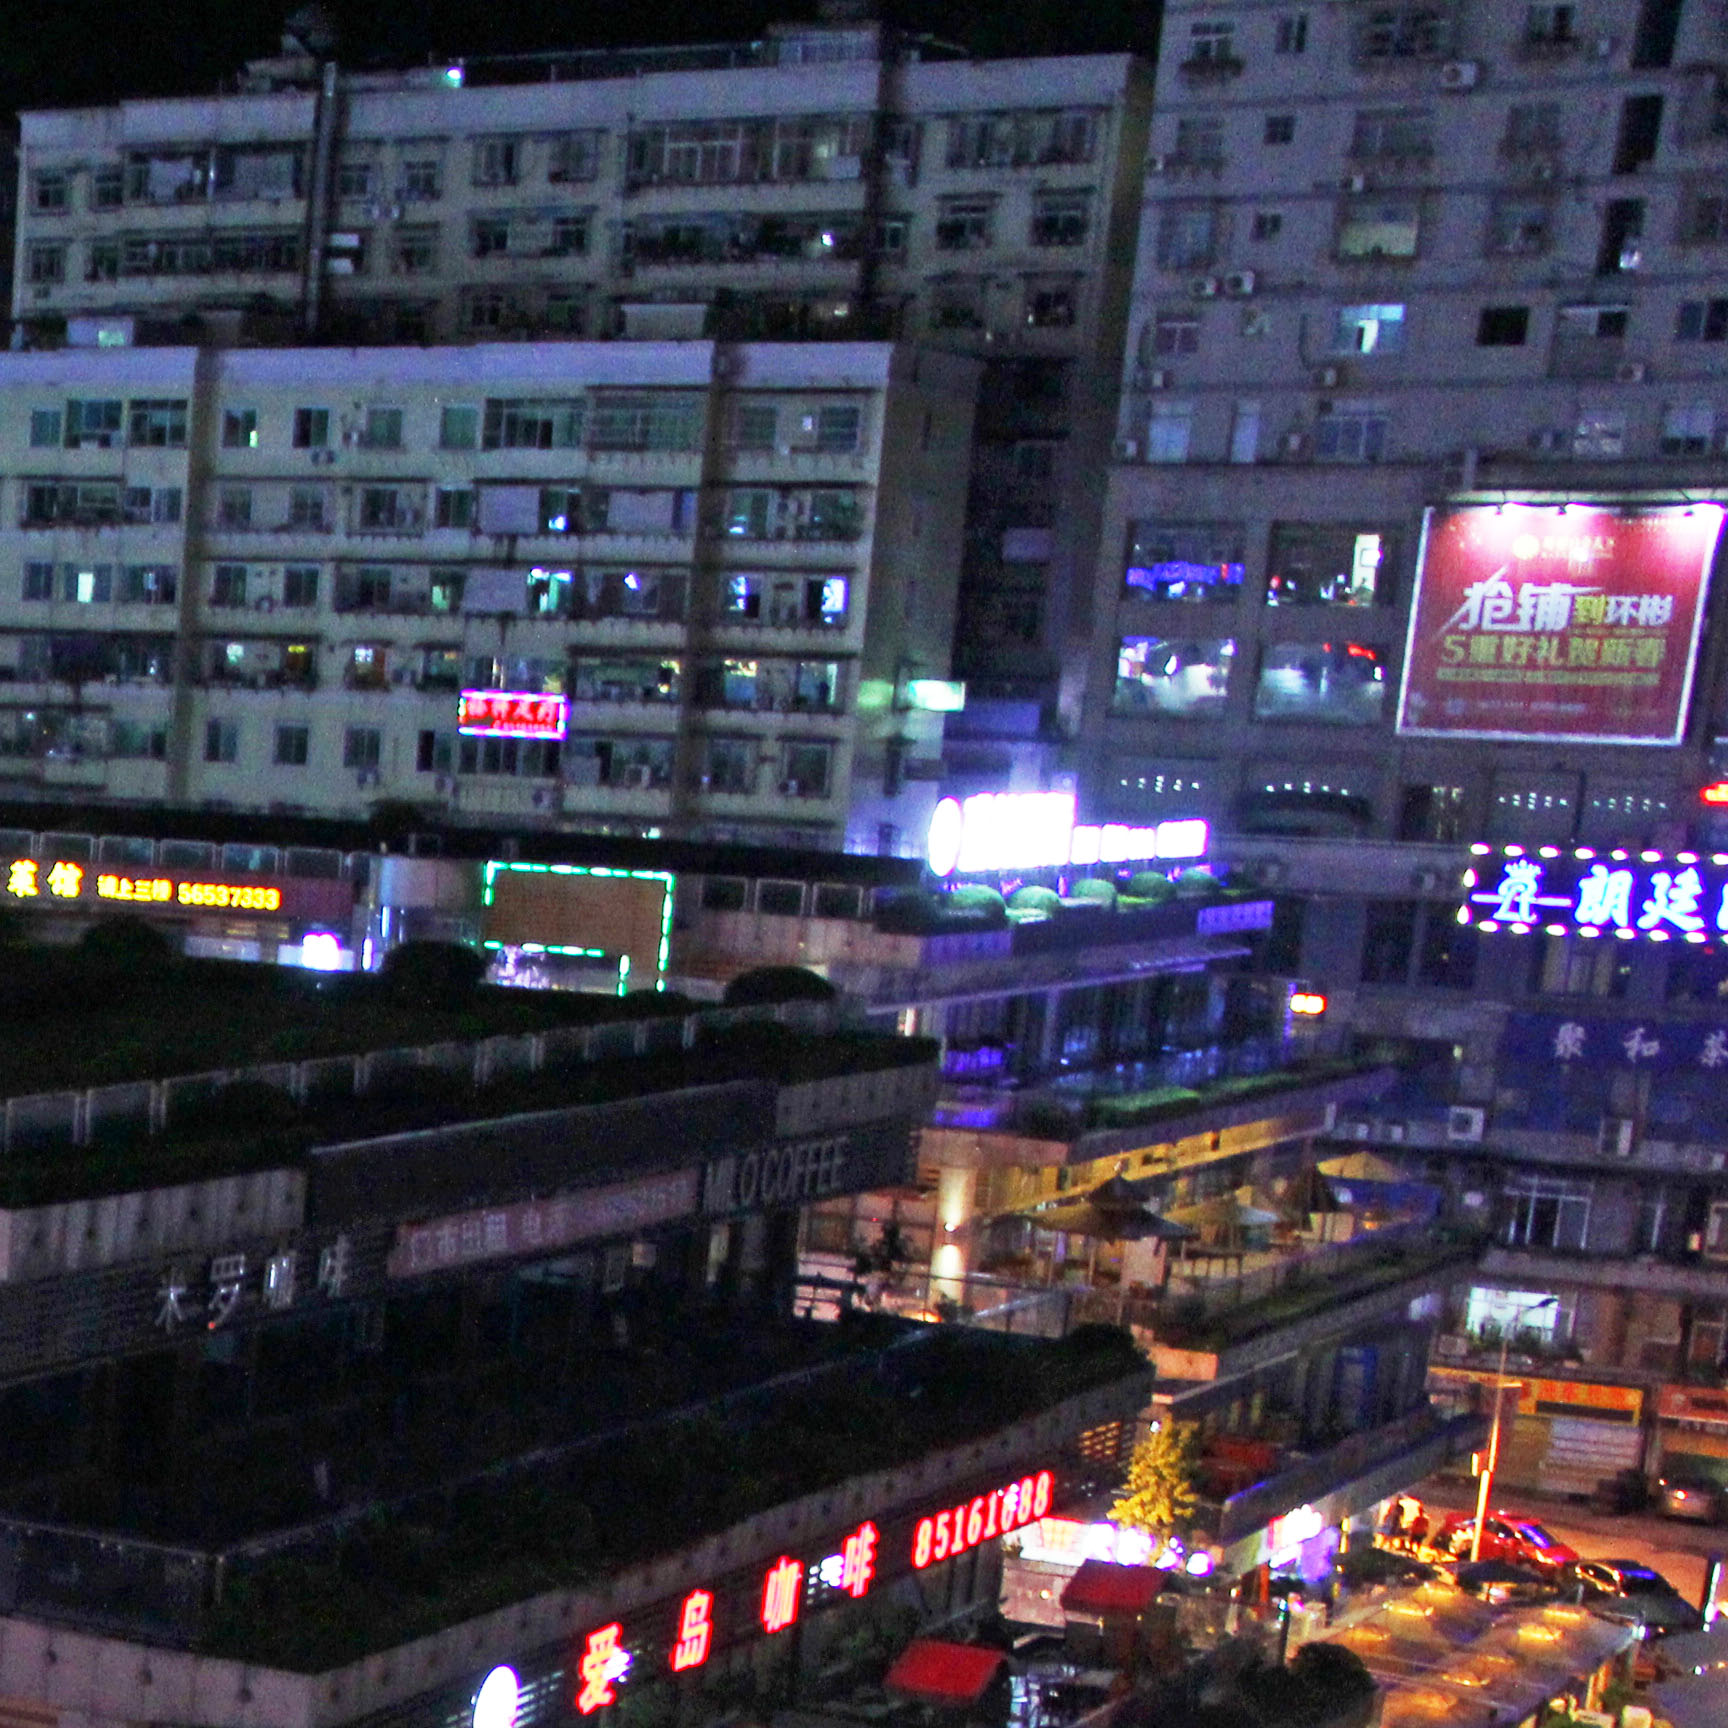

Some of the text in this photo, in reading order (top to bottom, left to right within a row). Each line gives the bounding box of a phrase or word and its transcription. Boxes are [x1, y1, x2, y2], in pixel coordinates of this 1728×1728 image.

[578, 1470, 1055, 1715] 爱岛咖啡 85161688
